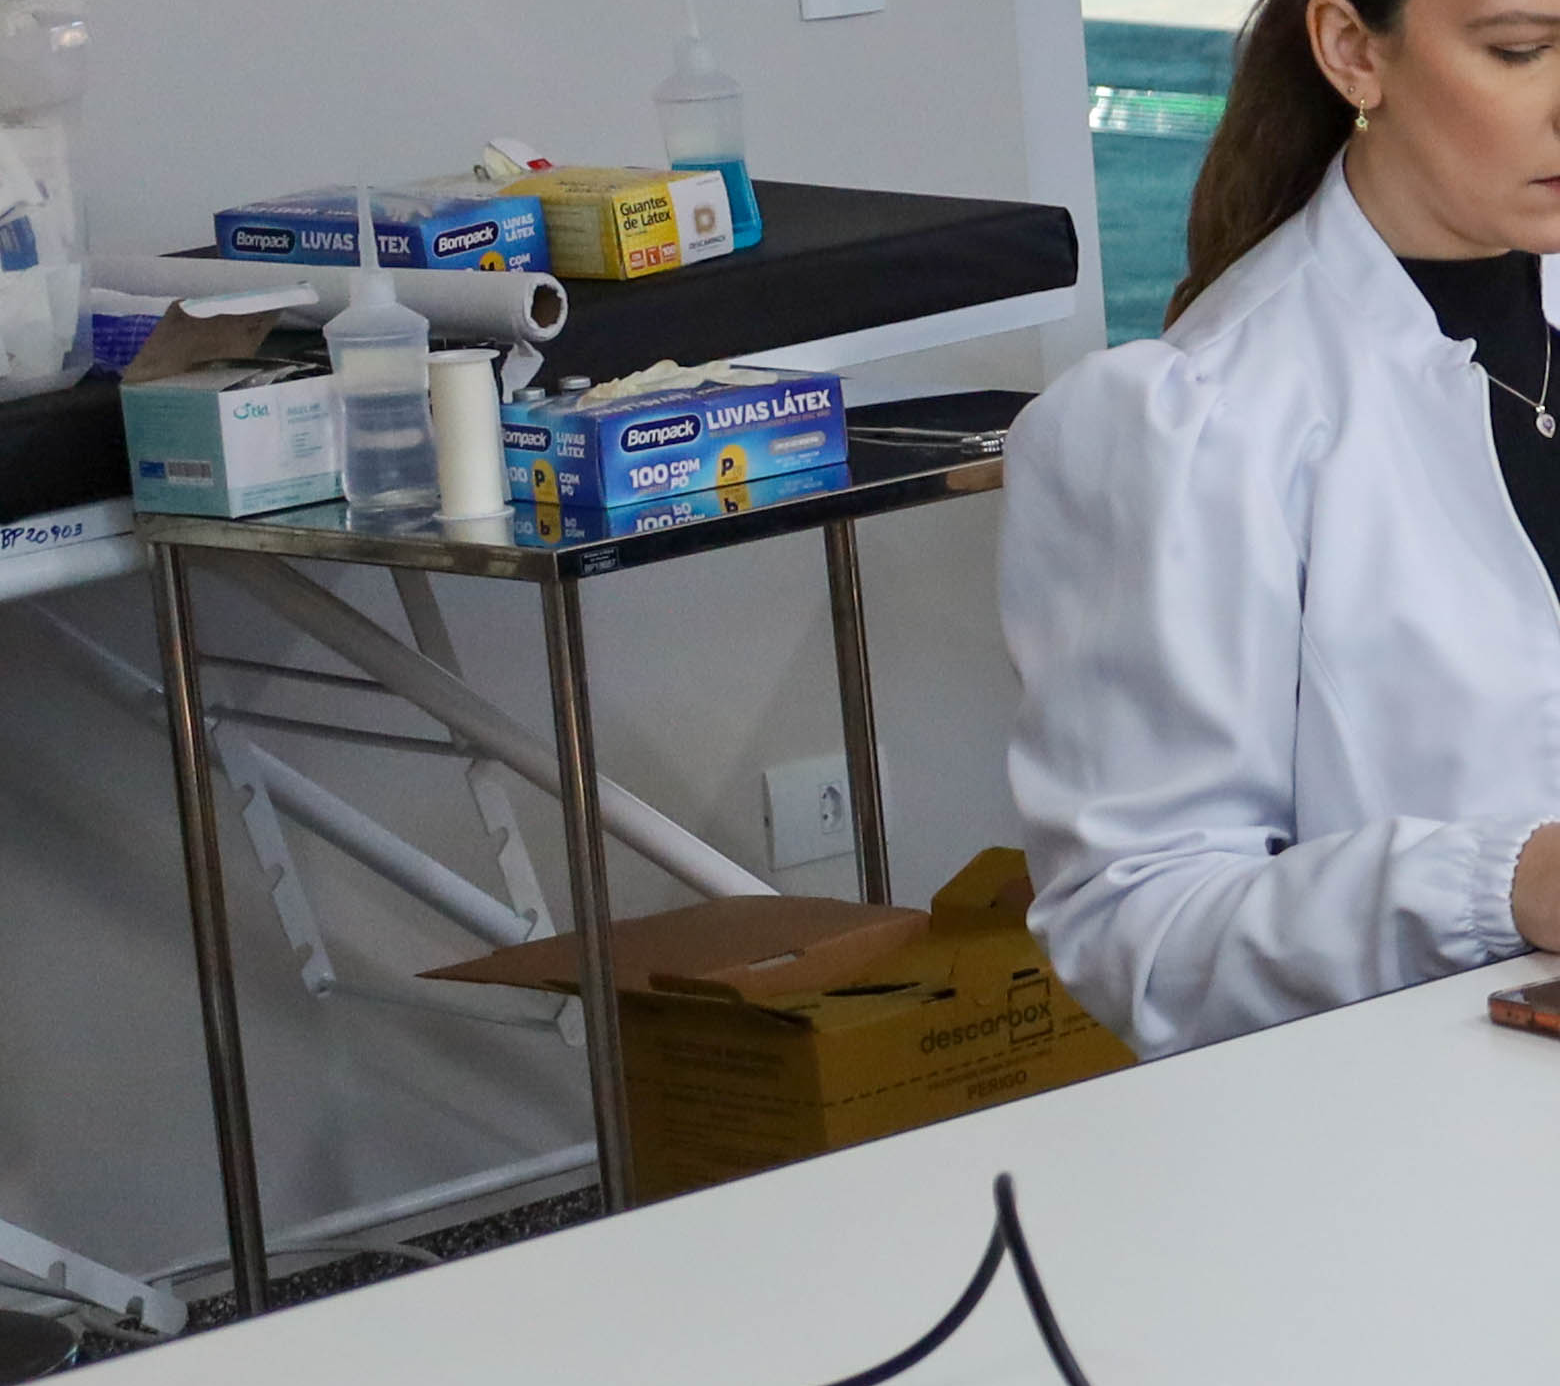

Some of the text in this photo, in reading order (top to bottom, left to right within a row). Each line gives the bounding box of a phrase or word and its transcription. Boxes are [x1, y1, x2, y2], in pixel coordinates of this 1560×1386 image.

[619, 195, 668, 216] Guantes
[501, 212, 535, 229] LUVAS
[622, 216, 639, 231] de
[235, 230, 411, 254] Bompack LUVAS TEX
[437, 224, 495, 252] Bompack
[508, 252, 532, 268] COM
[626, 419, 696, 447] Bompack
[705, 400, 770, 431] LUVAS
[771, 389, 832, 417] LÁTEX
[628, 463, 669, 489] 100
[669, 458, 701, 477] COM
[919, 1000, 1051, 1055] descarbox
